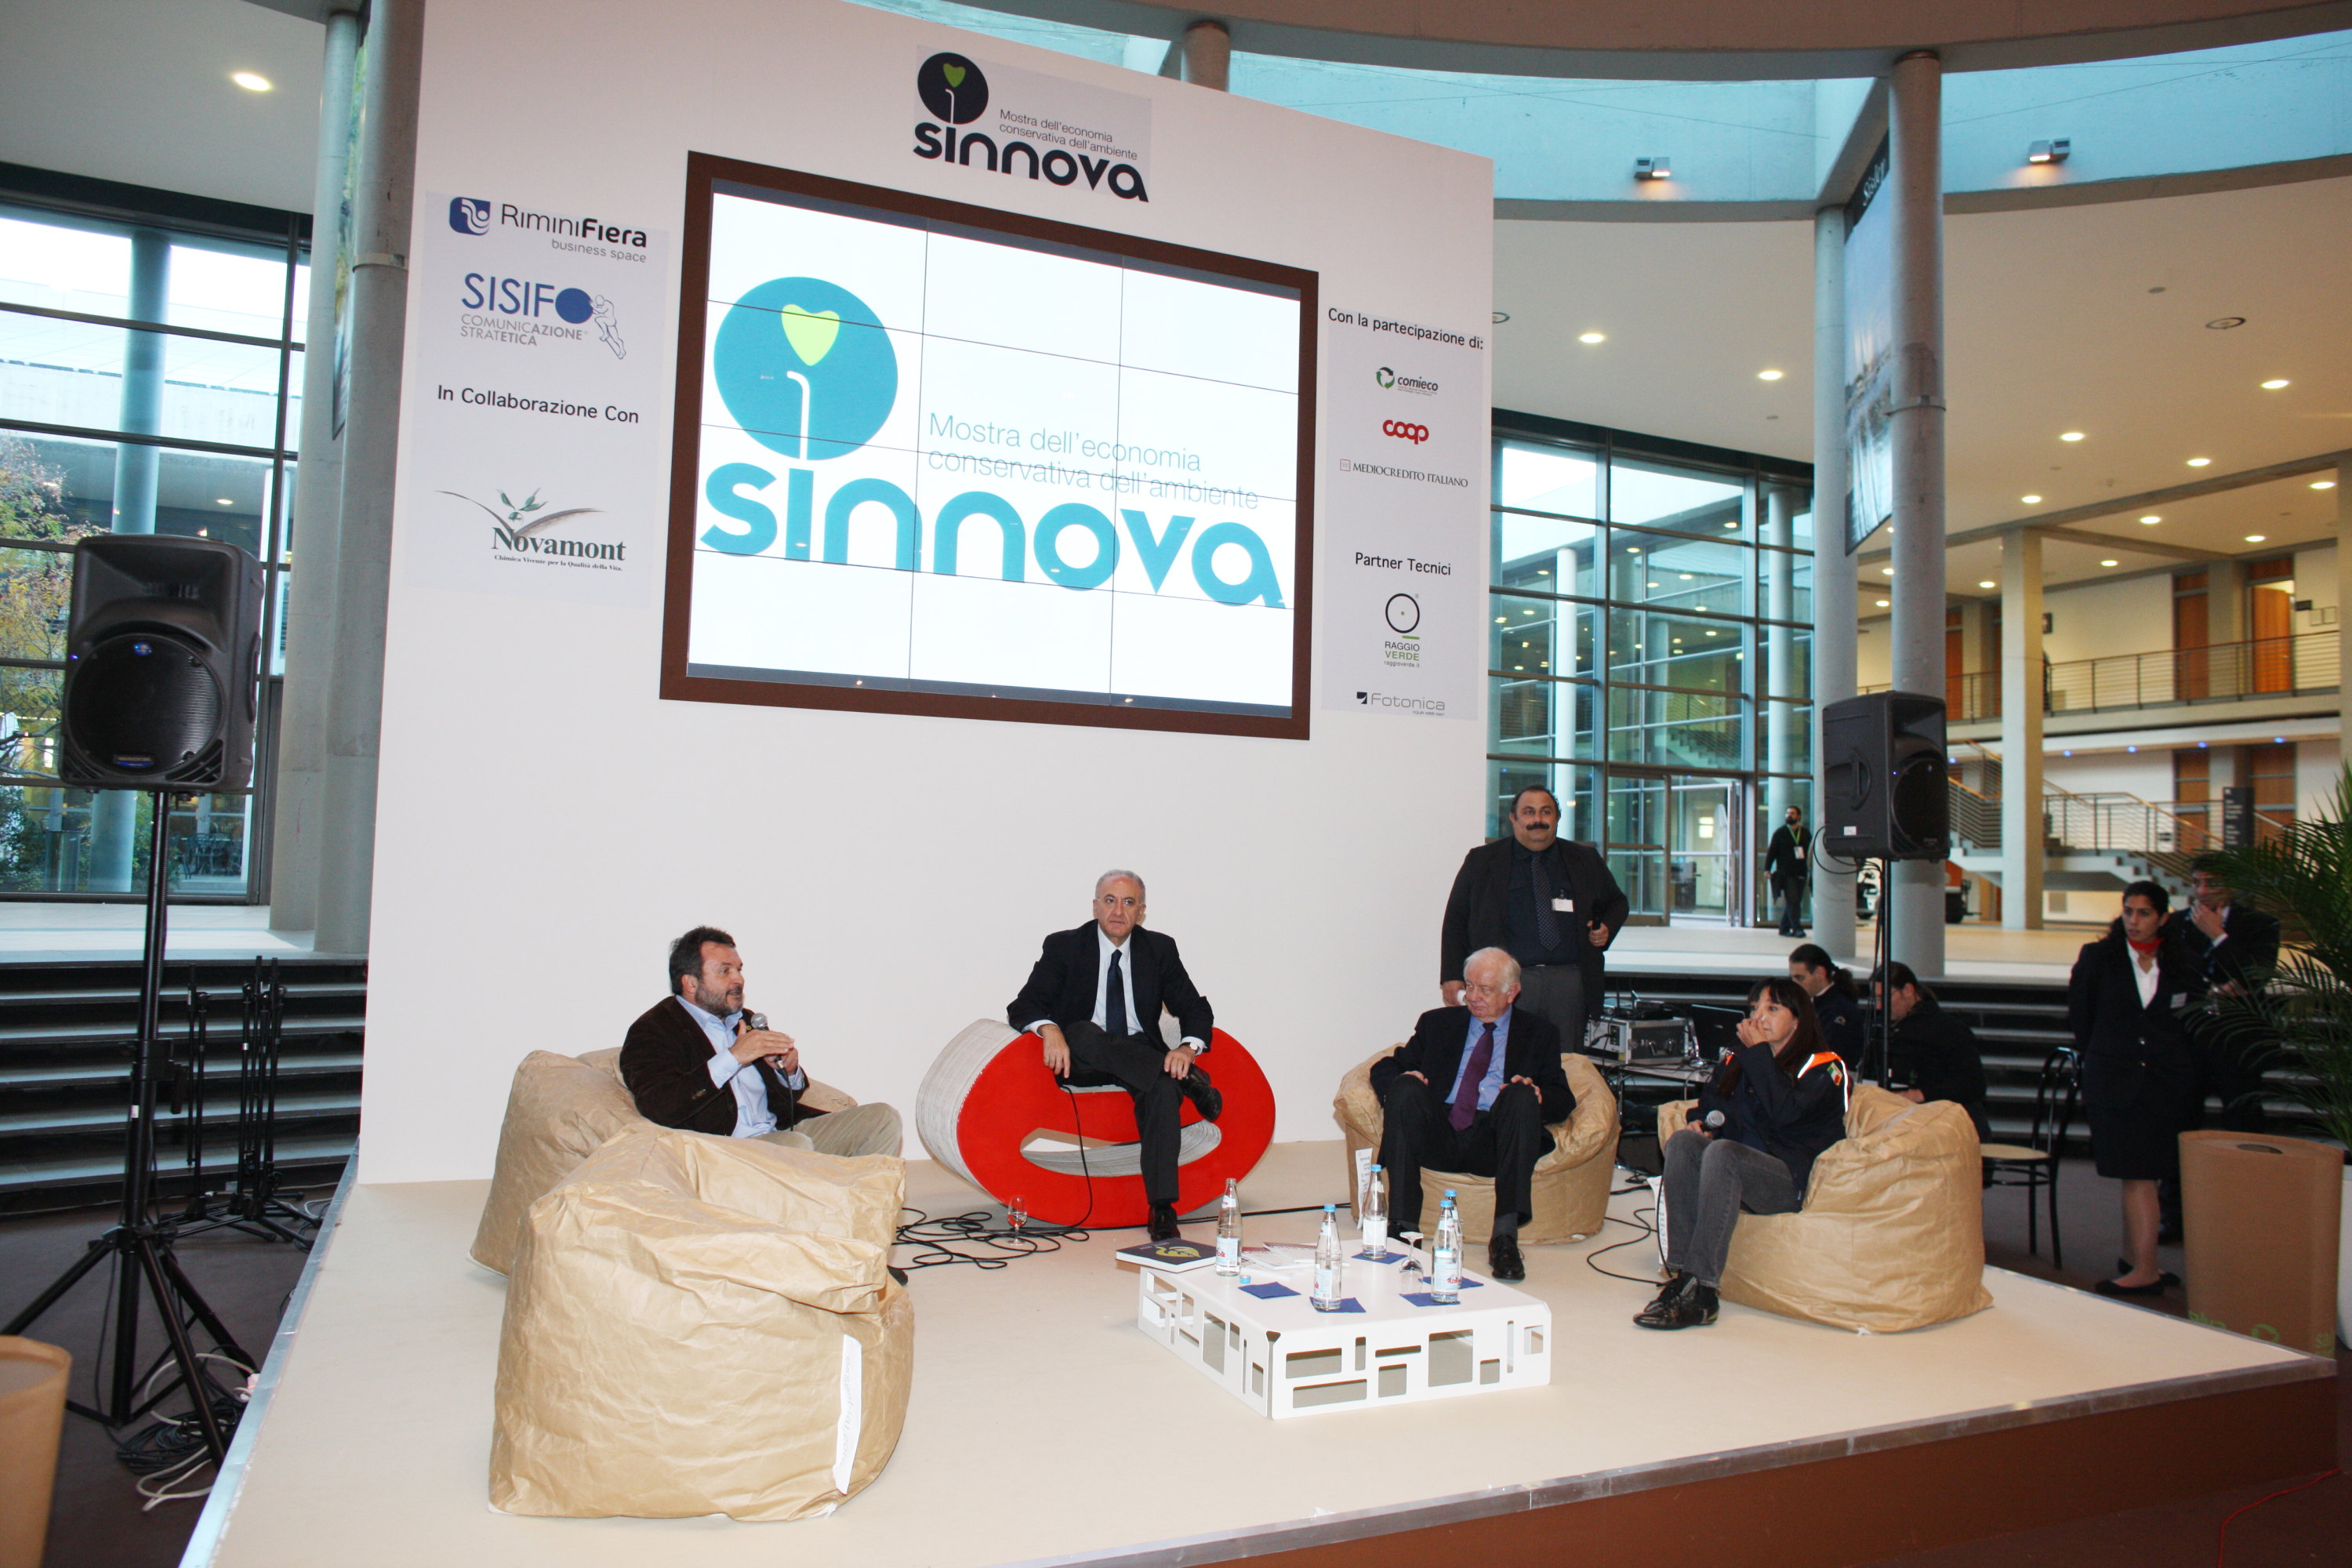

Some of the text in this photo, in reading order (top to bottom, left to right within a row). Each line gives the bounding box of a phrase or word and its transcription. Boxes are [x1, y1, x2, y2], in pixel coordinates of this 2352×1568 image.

[1000, 109, 1112, 143] Mostra dell'economia
[1000, 123, 1138, 161] conservativa dell'ambiente
[913, 122, 1149, 202] sinnova
[501, 204, 648, 248] RiminiFiera
[551, 238, 647, 263] business space
[460, 326, 538, 347] STRATETICA
[461, 314, 583, 340] COMUNICAZIONE
[1328, 307, 1483, 350] Con la partecipazione di:
[1397, 376, 1438, 391] comieco
[437, 384, 639, 423] In Collaborazione Con
[930, 412, 1201, 472] Mostra dell'economia
[1382, 419, 1429, 445] coop
[928, 450, 1258, 510] conservativa dell'ambiente
[1352, 463, 1468, 488] MEDIOCREDITO ITALIANO
[491, 527, 626, 561] Novamont
[700, 462, 1287, 609] sinnova
[1355, 552, 1450, 575] Partner Tecnici
[1385, 641, 1420, 652] RAGGIO
[1385, 651, 1420, 661] VERDE
[1371, 692, 1444, 711] Fotonica
